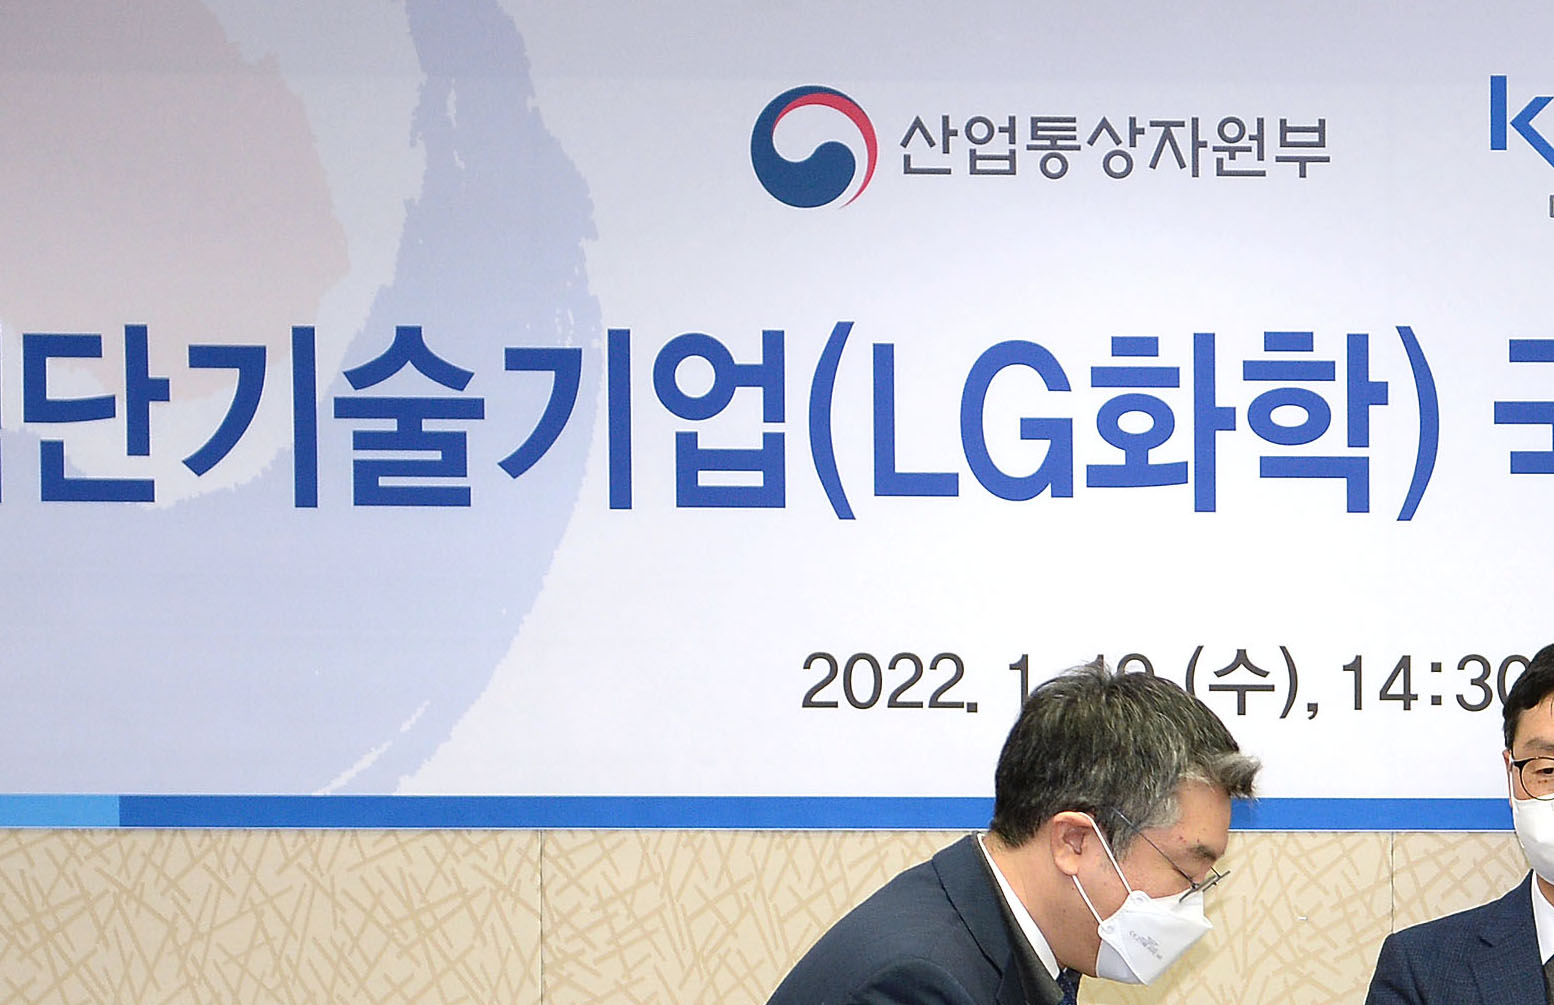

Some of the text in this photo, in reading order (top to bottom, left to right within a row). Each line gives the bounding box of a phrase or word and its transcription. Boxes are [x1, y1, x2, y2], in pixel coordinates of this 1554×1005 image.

[899, 114, 1331, 180] 산업통상자원부
[0, 321, 1440, 522] 단기술기업(LG화학)
[801, 652, 978, 713] 2022.
